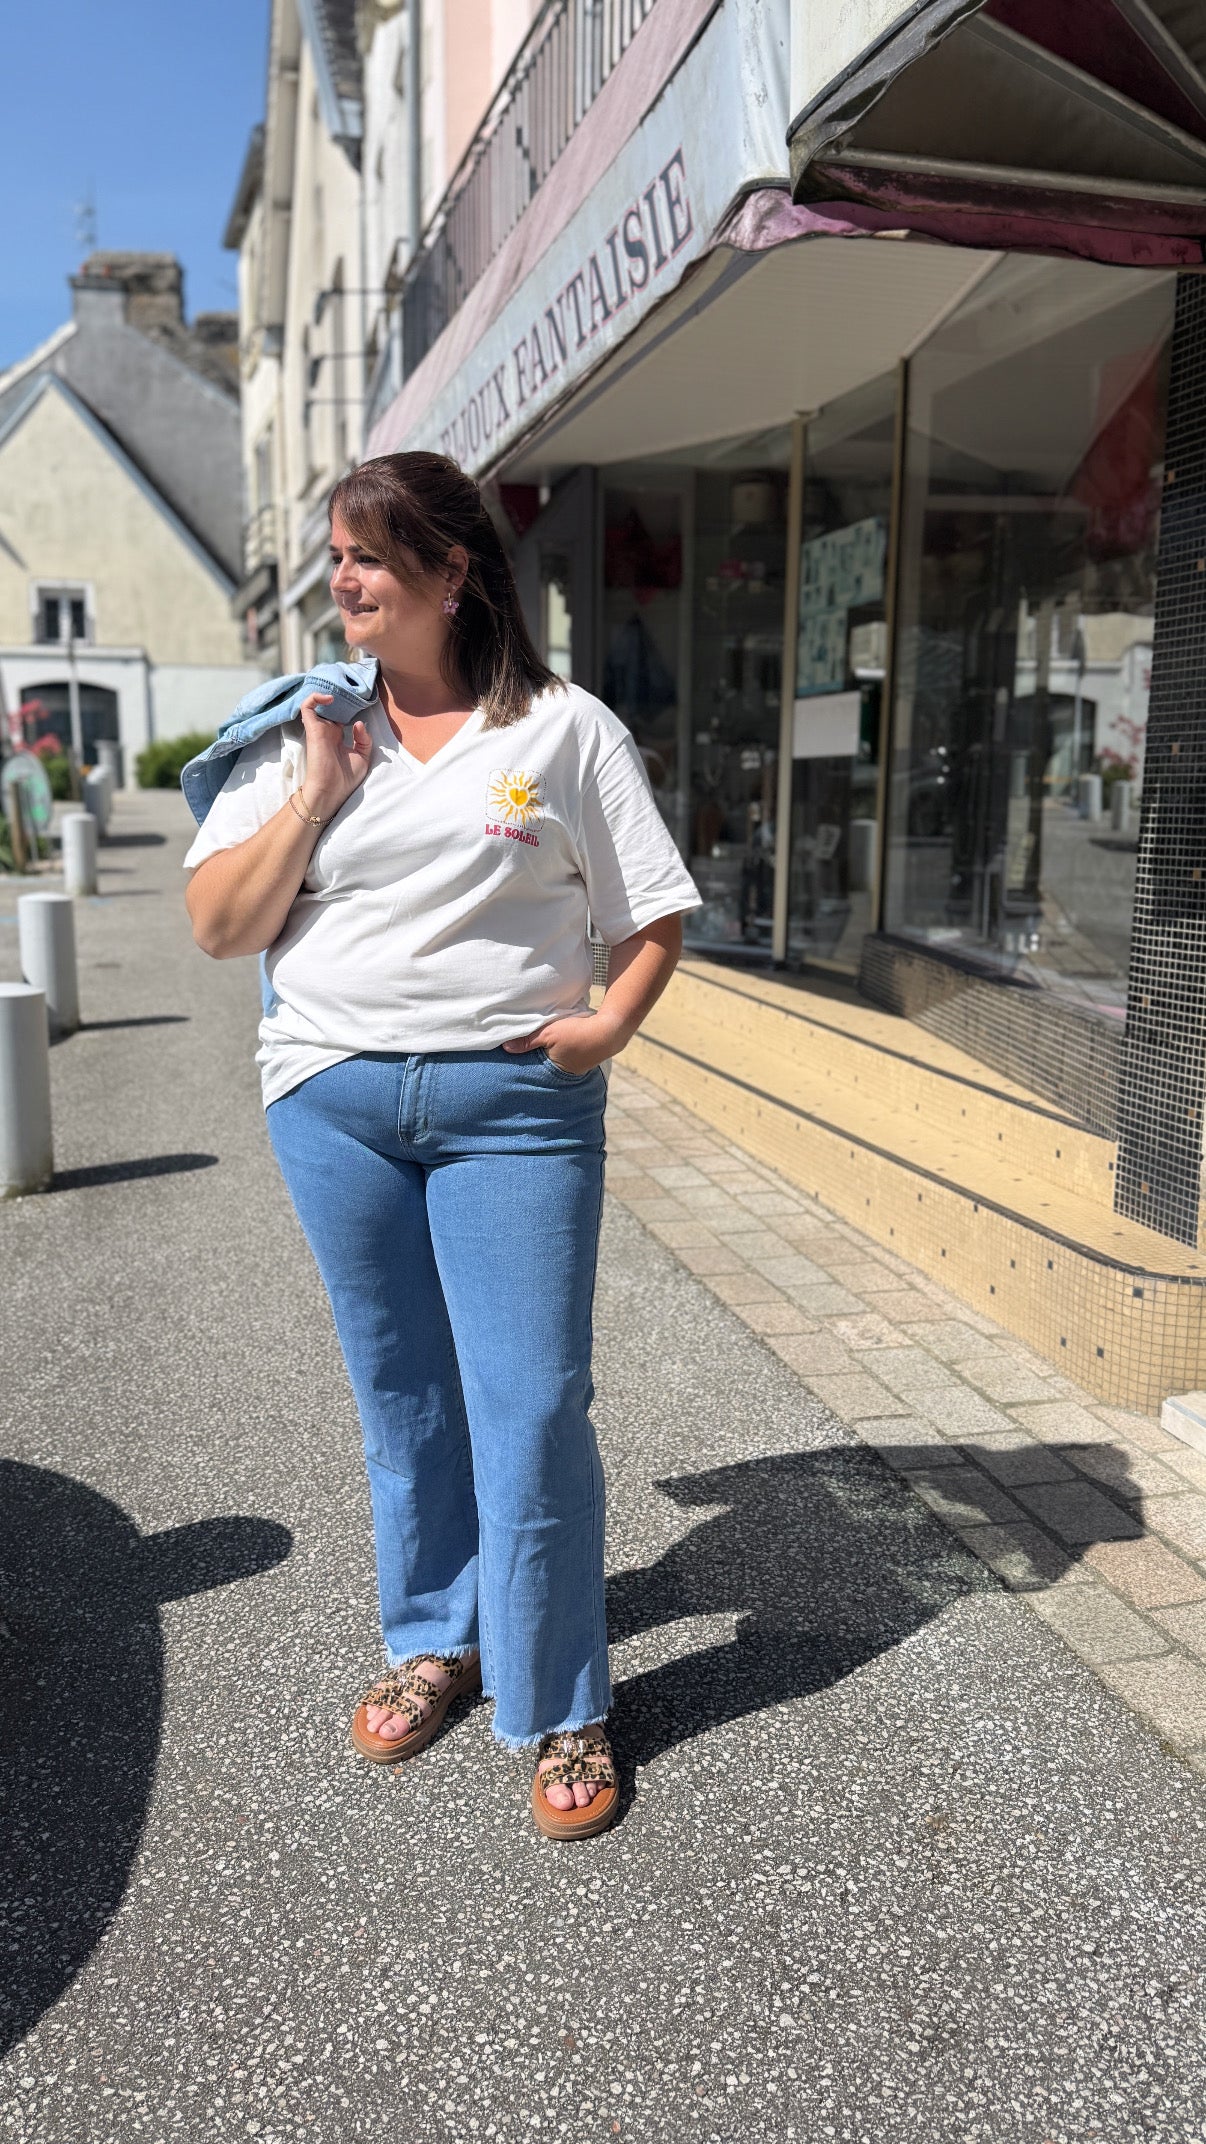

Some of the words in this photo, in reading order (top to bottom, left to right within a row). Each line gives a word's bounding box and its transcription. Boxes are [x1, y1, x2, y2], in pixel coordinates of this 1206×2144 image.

[512, 146, 694, 408] FANTAISIE
[485, 824, 501, 836] LE
[504, 827, 539, 847] SOLEIL
